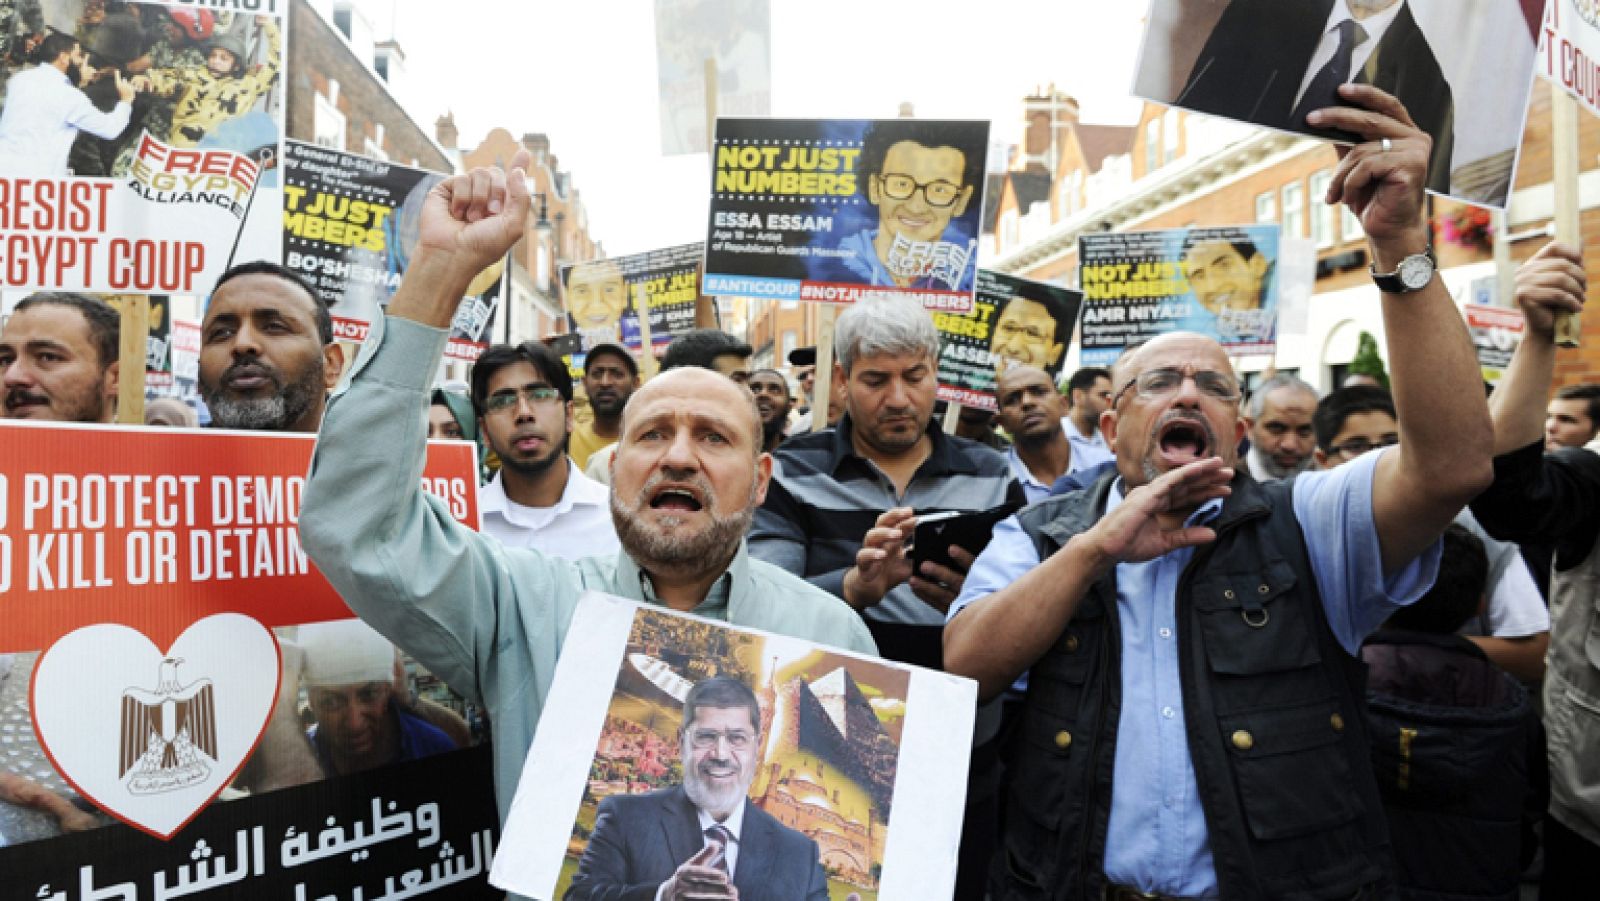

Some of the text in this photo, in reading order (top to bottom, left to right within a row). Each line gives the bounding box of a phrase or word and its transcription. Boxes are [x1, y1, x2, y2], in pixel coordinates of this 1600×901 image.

[139, 134, 257, 190] FREE
[717, 145, 861, 171] NOT JUST
[132, 159, 249, 202] EGYPT
[716, 170, 857, 196] NUMBERS
[0, 178, 113, 233] RESIST
[128, 180, 244, 220] ALLIANCE
[305, 191, 391, 228] JUST
[283, 210, 386, 252] MBERS
[714, 212, 833, 232] ESSA ESSAM
[0, 234, 205, 291] GYPT COUP
[1082, 261, 1190, 282] NOT JUST
[707, 279, 798, 295] #ANTICOUP
[1083, 280, 1189, 300] NUMBERS
[333, 321, 369, 339] NOT
[934, 312, 990, 340] BERS
[1083, 306, 1125, 322] AMR
[24, 472, 201, 531] PROTECT
[211, 474, 306, 526] DEMO
[28, 531, 113, 592] KILL
[126, 529, 177, 585] OR
[189, 527, 309, 582] DETAIN
